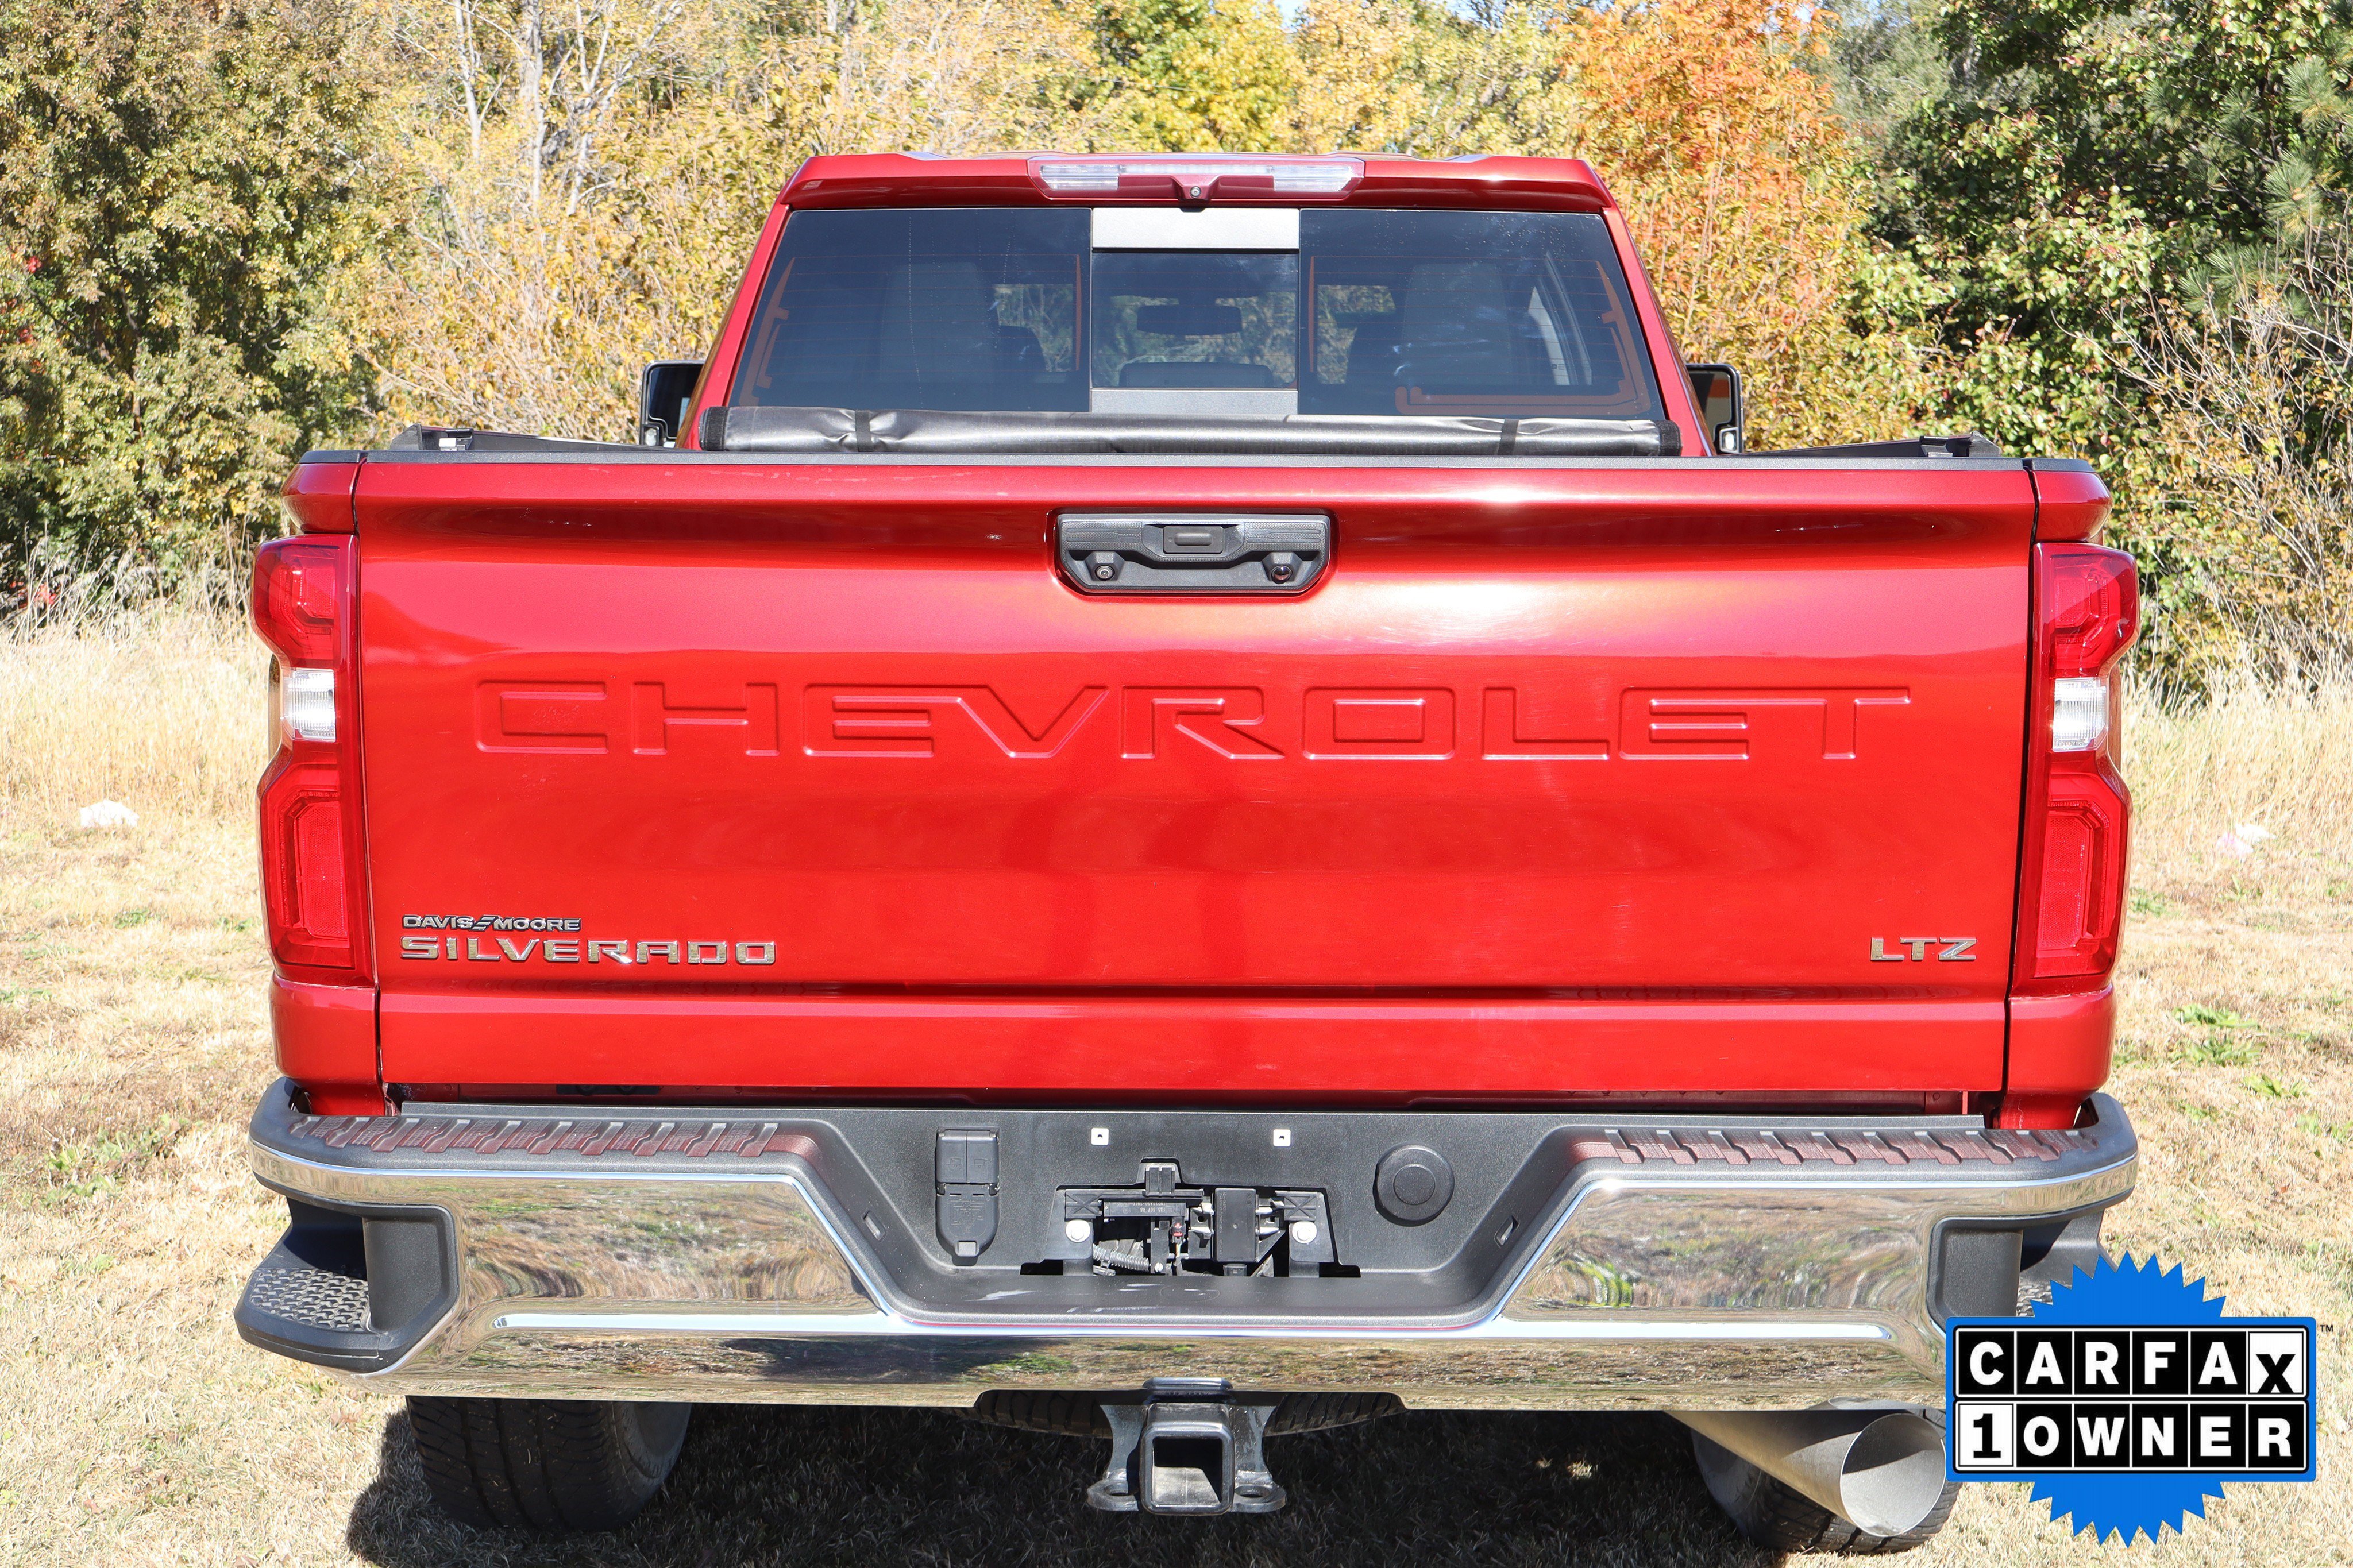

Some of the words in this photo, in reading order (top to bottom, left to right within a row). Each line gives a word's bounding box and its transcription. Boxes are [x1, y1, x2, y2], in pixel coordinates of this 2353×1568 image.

[475, 679, 1911, 760] CHEVROLET
[403, 914, 475, 929] DAVIS
[493, 916, 581, 932] MOORE
[401, 936, 776, 964] SILVERADO
[1870, 937, 1977, 960] LTZ
